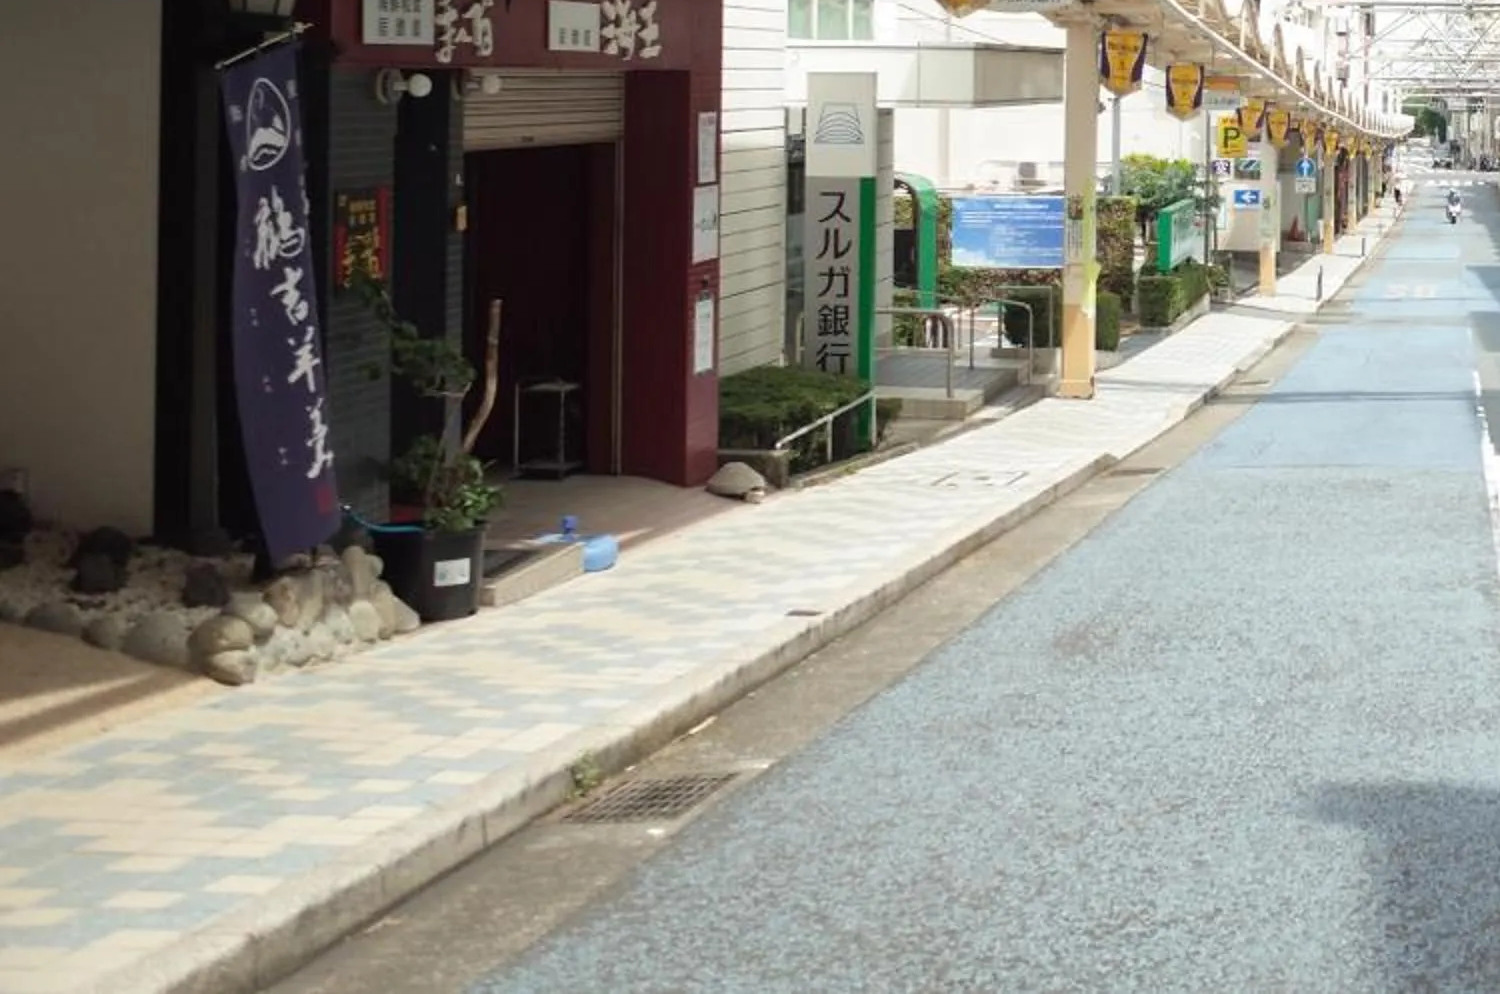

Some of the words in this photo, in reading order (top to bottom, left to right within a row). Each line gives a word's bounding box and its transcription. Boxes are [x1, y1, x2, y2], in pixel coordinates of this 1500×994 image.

[1223, 127, 1240, 148] P
[816, 191, 853, 375] スルガ銀行
